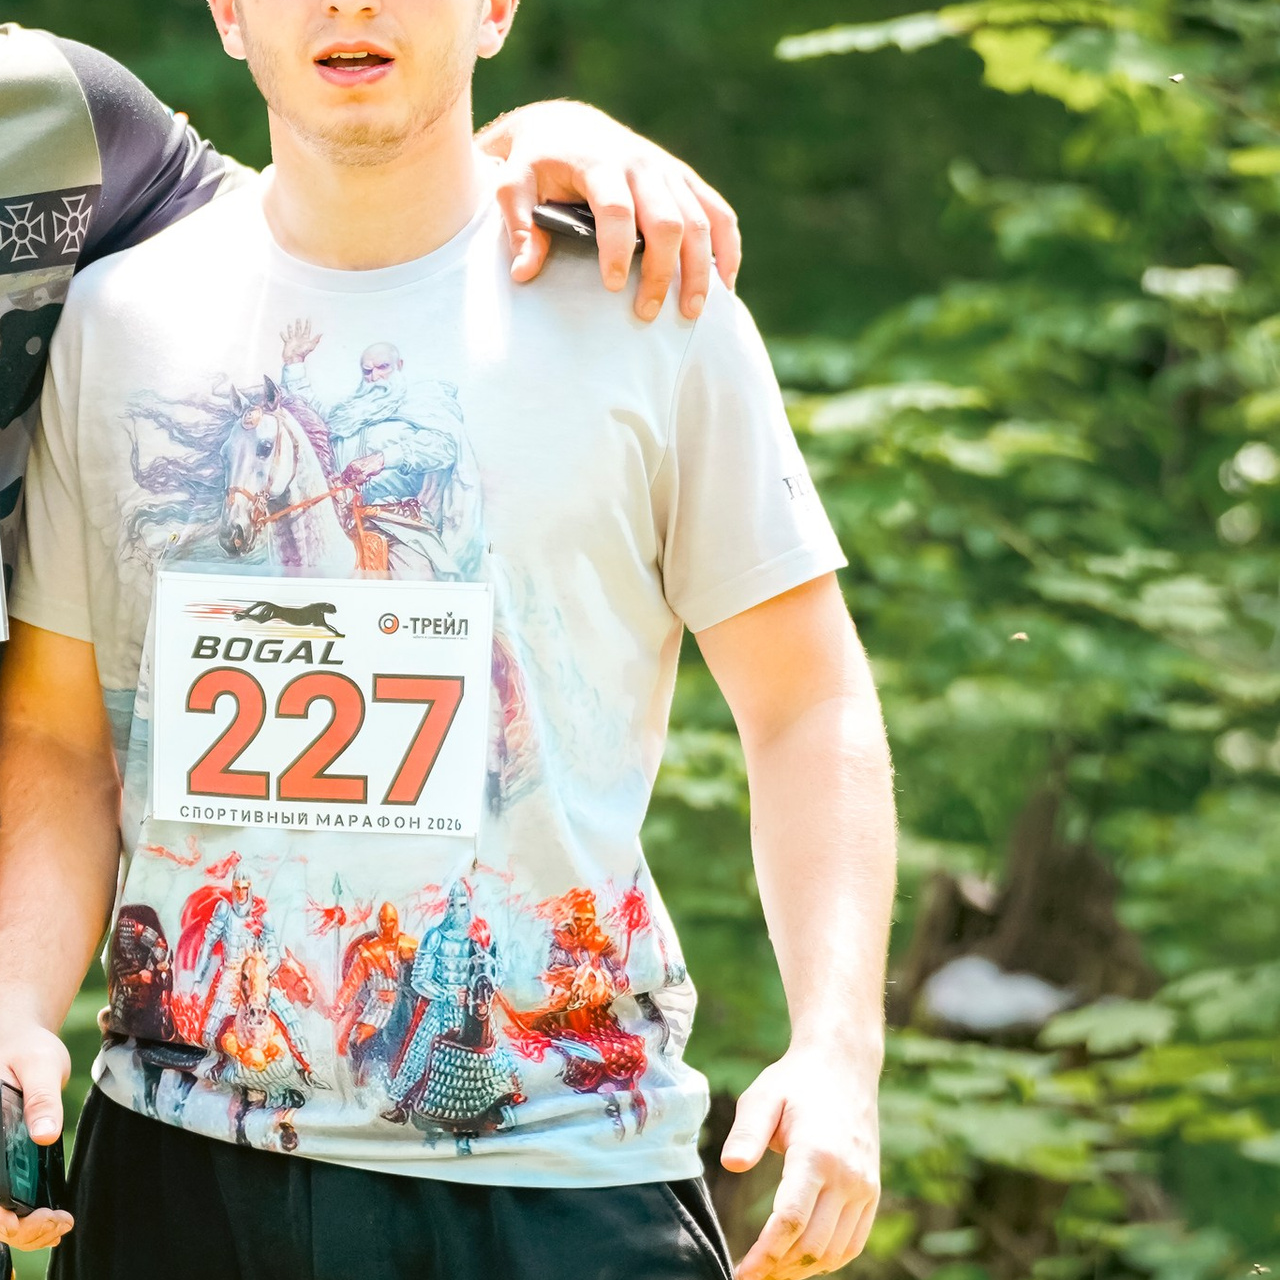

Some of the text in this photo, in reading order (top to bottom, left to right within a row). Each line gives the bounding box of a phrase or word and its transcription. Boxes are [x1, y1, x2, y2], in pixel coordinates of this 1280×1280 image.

[191, 635, 345, 665] BOGAL
[185, 666, 465, 806] 227
[180, 805, 462, 831] СПОРТИВНЫЙ МАРАФОН 2026
